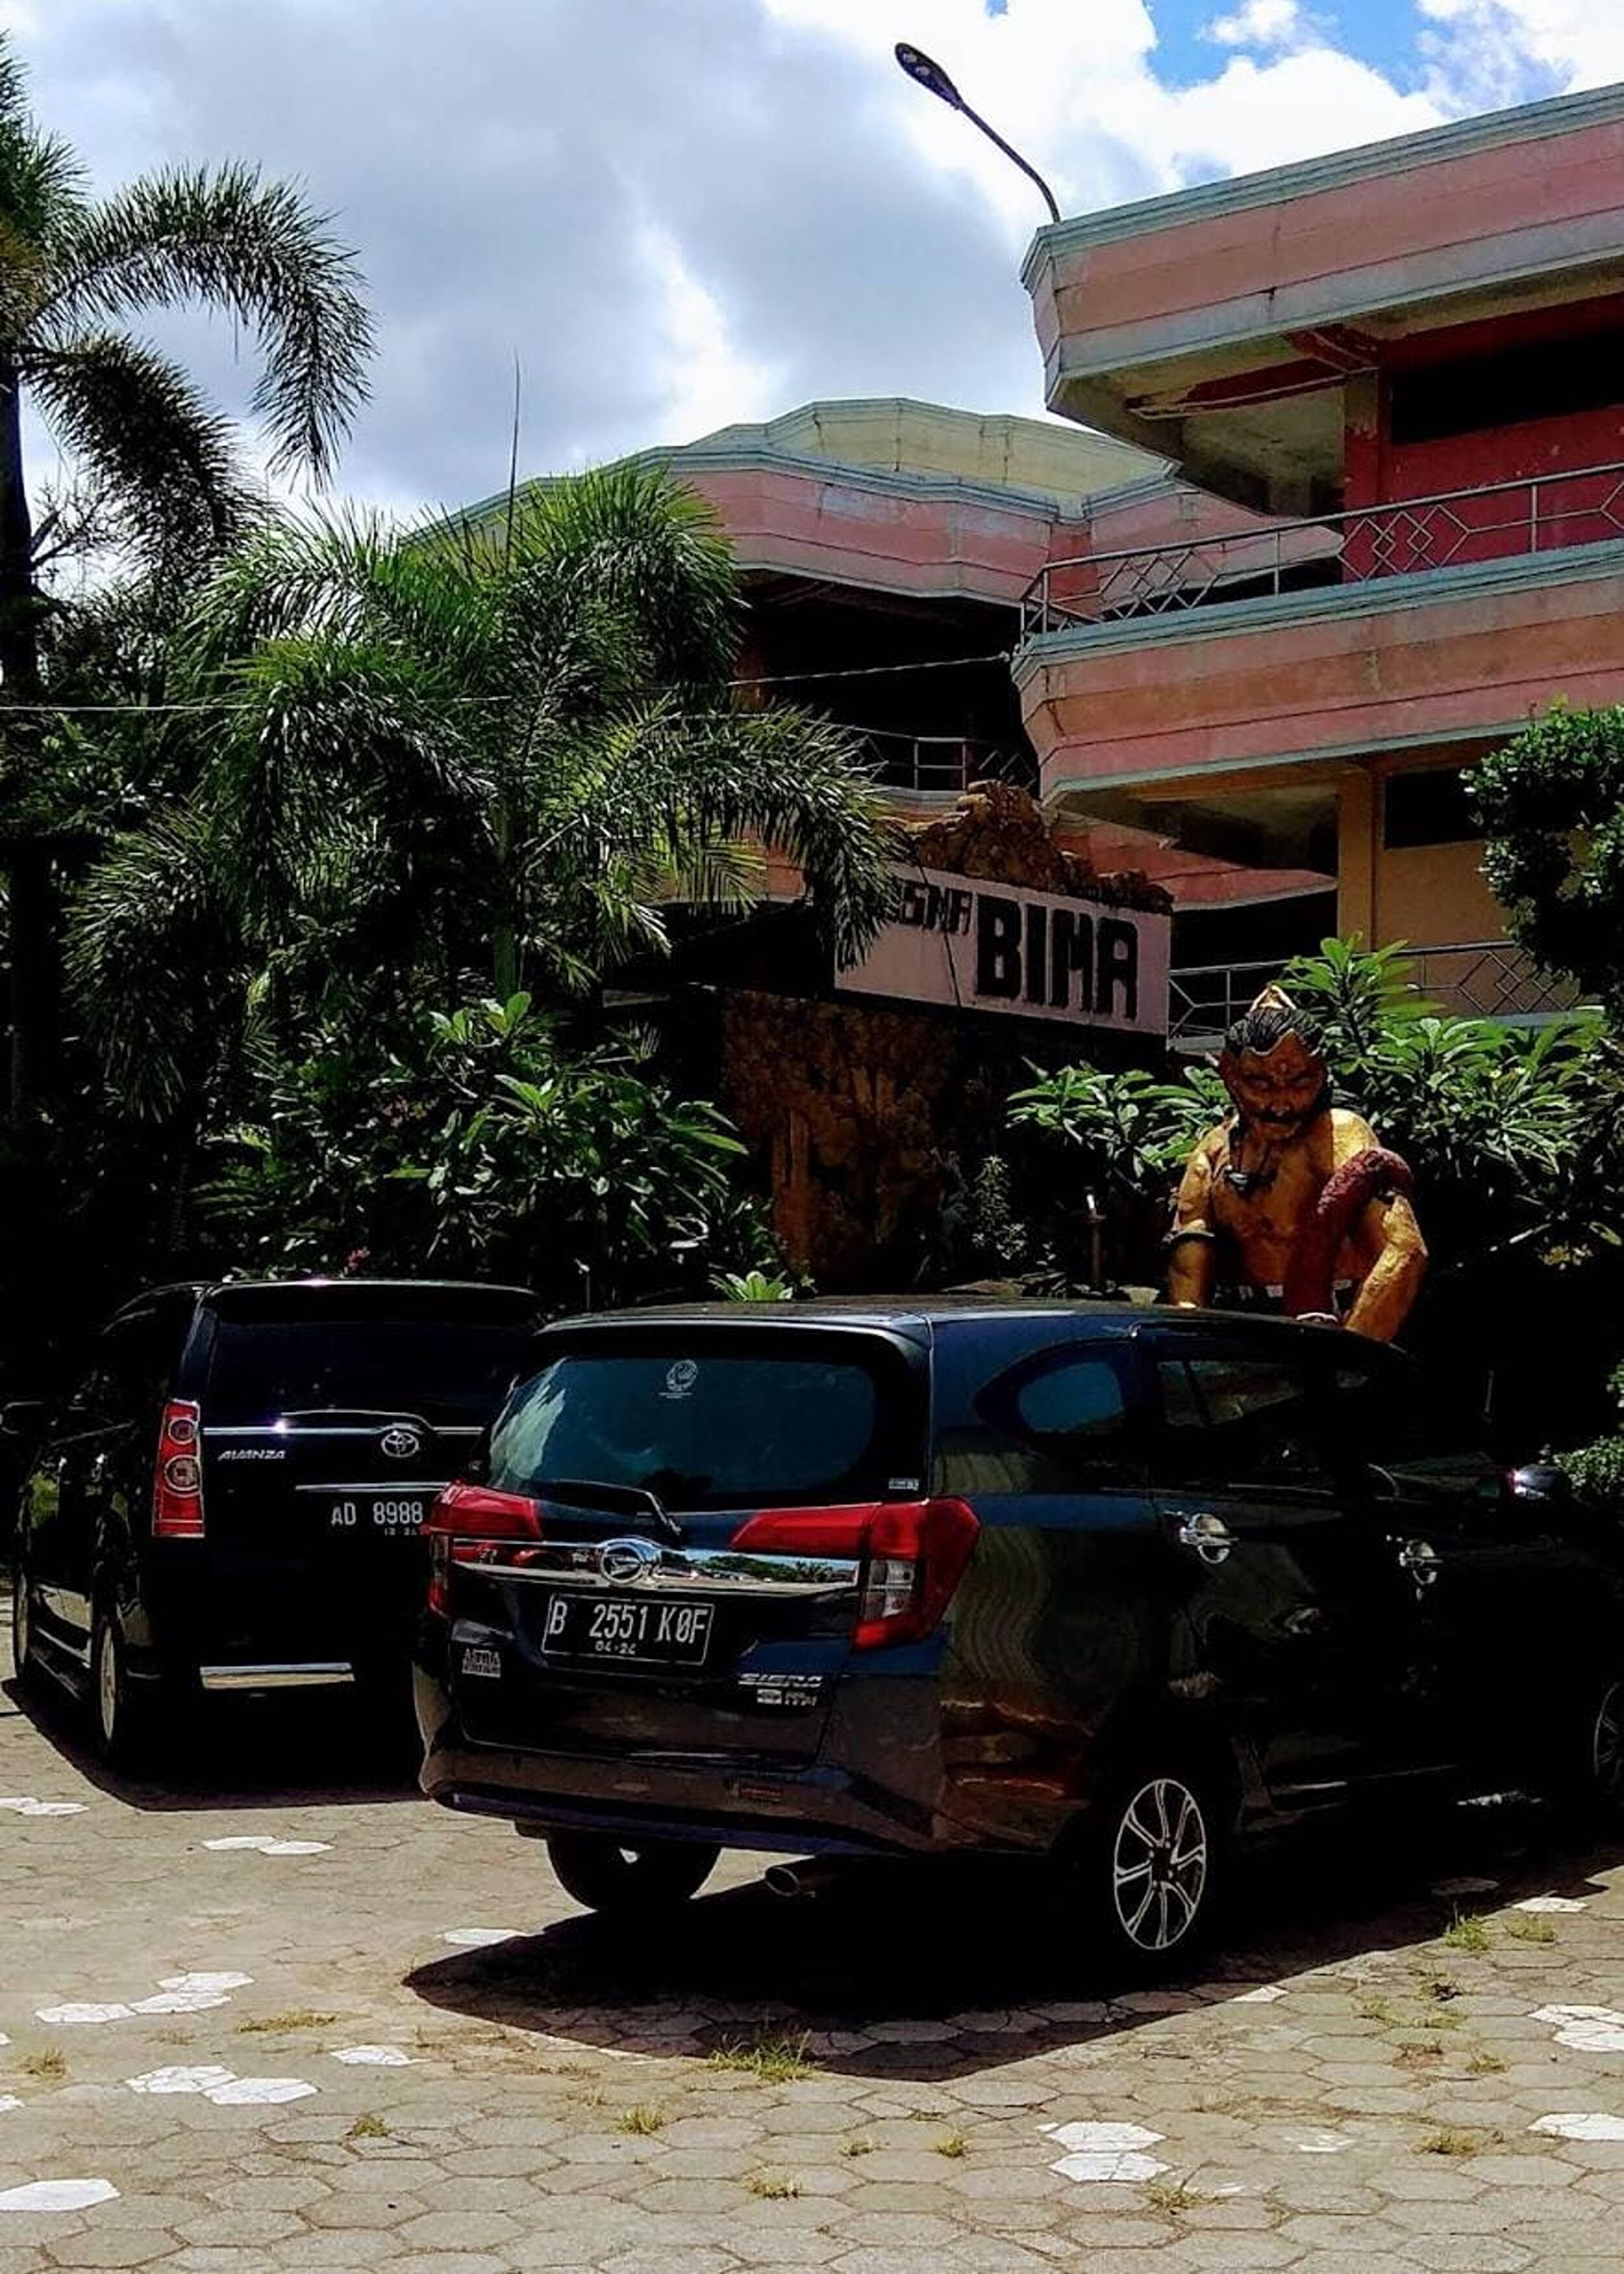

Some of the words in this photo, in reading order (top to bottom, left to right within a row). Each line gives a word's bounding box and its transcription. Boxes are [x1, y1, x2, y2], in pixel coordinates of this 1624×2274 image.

[976, 893, 1138, 1021] BIMA
[217, 1449, 285, 1461] AVANZA
[331, 1501, 357, 1526] AD
[373, 1501, 423, 1524] 8988
[550, 1600, 568, 1634] B
[589, 1603, 648, 1640] 2551
